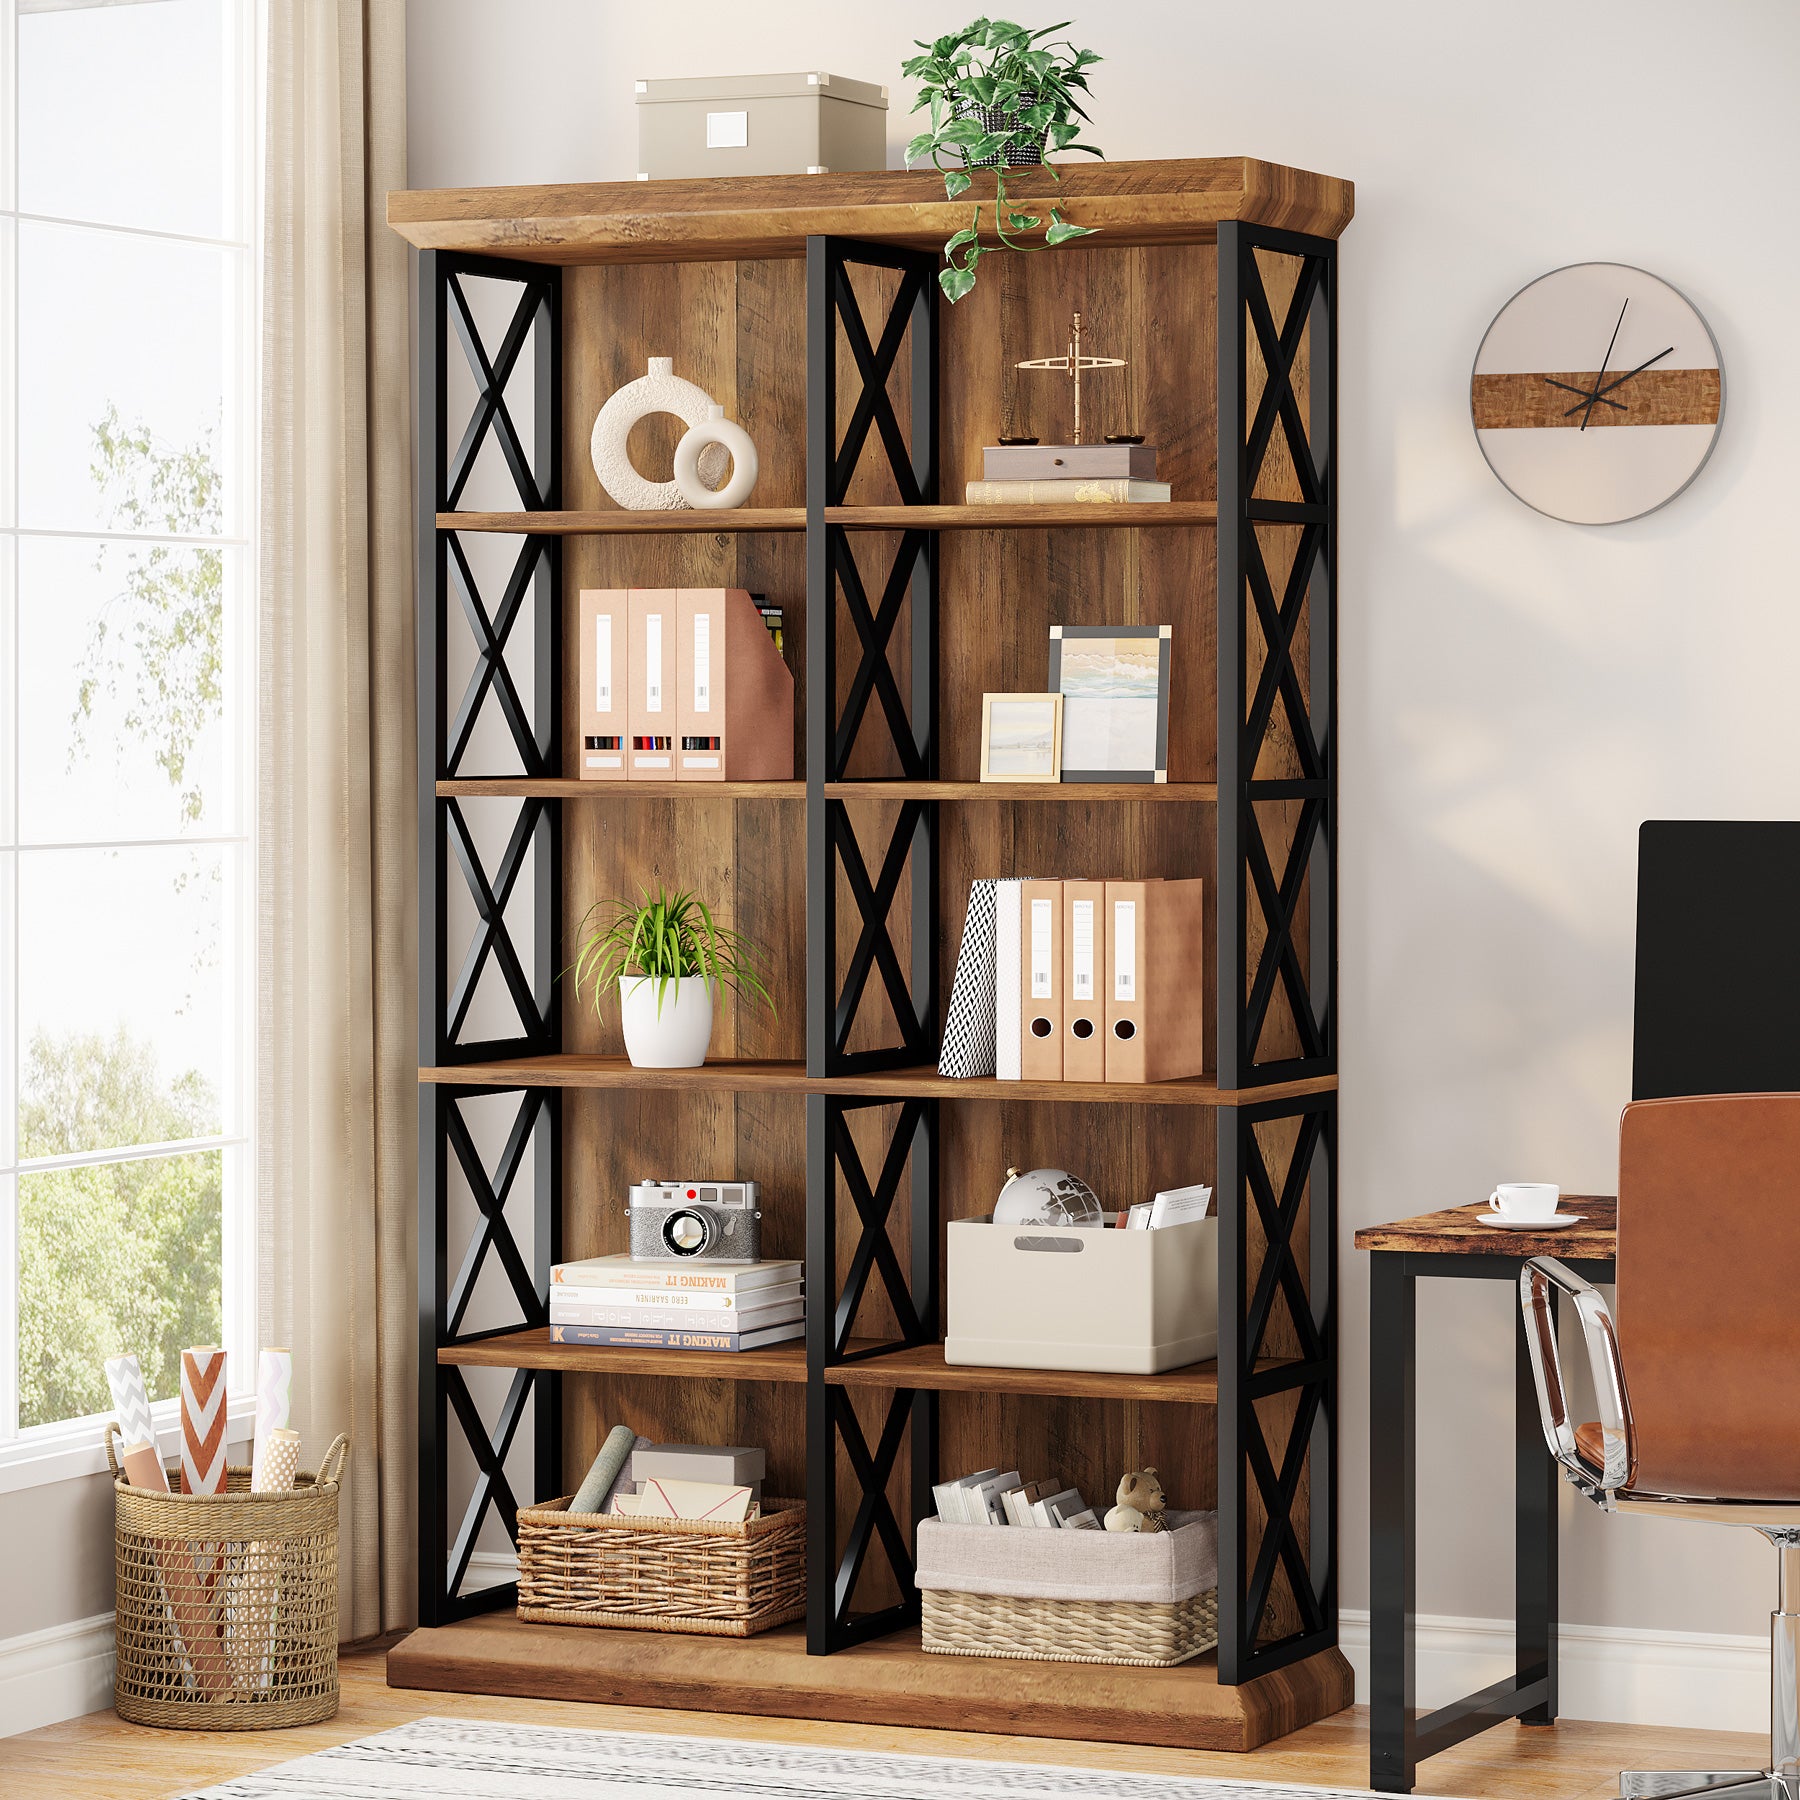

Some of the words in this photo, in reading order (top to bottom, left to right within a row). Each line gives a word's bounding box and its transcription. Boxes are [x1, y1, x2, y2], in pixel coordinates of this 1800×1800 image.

[665, 1275, 677, 1286] IT
[680, 1275, 727, 1288] MAKING
[635, 1294, 669, 1304] SAARINEN
[672, 1295, 689, 1305] EERO
[667, 1334, 681, 1346] IT
[682, 1334, 731, 1348] MAKING
